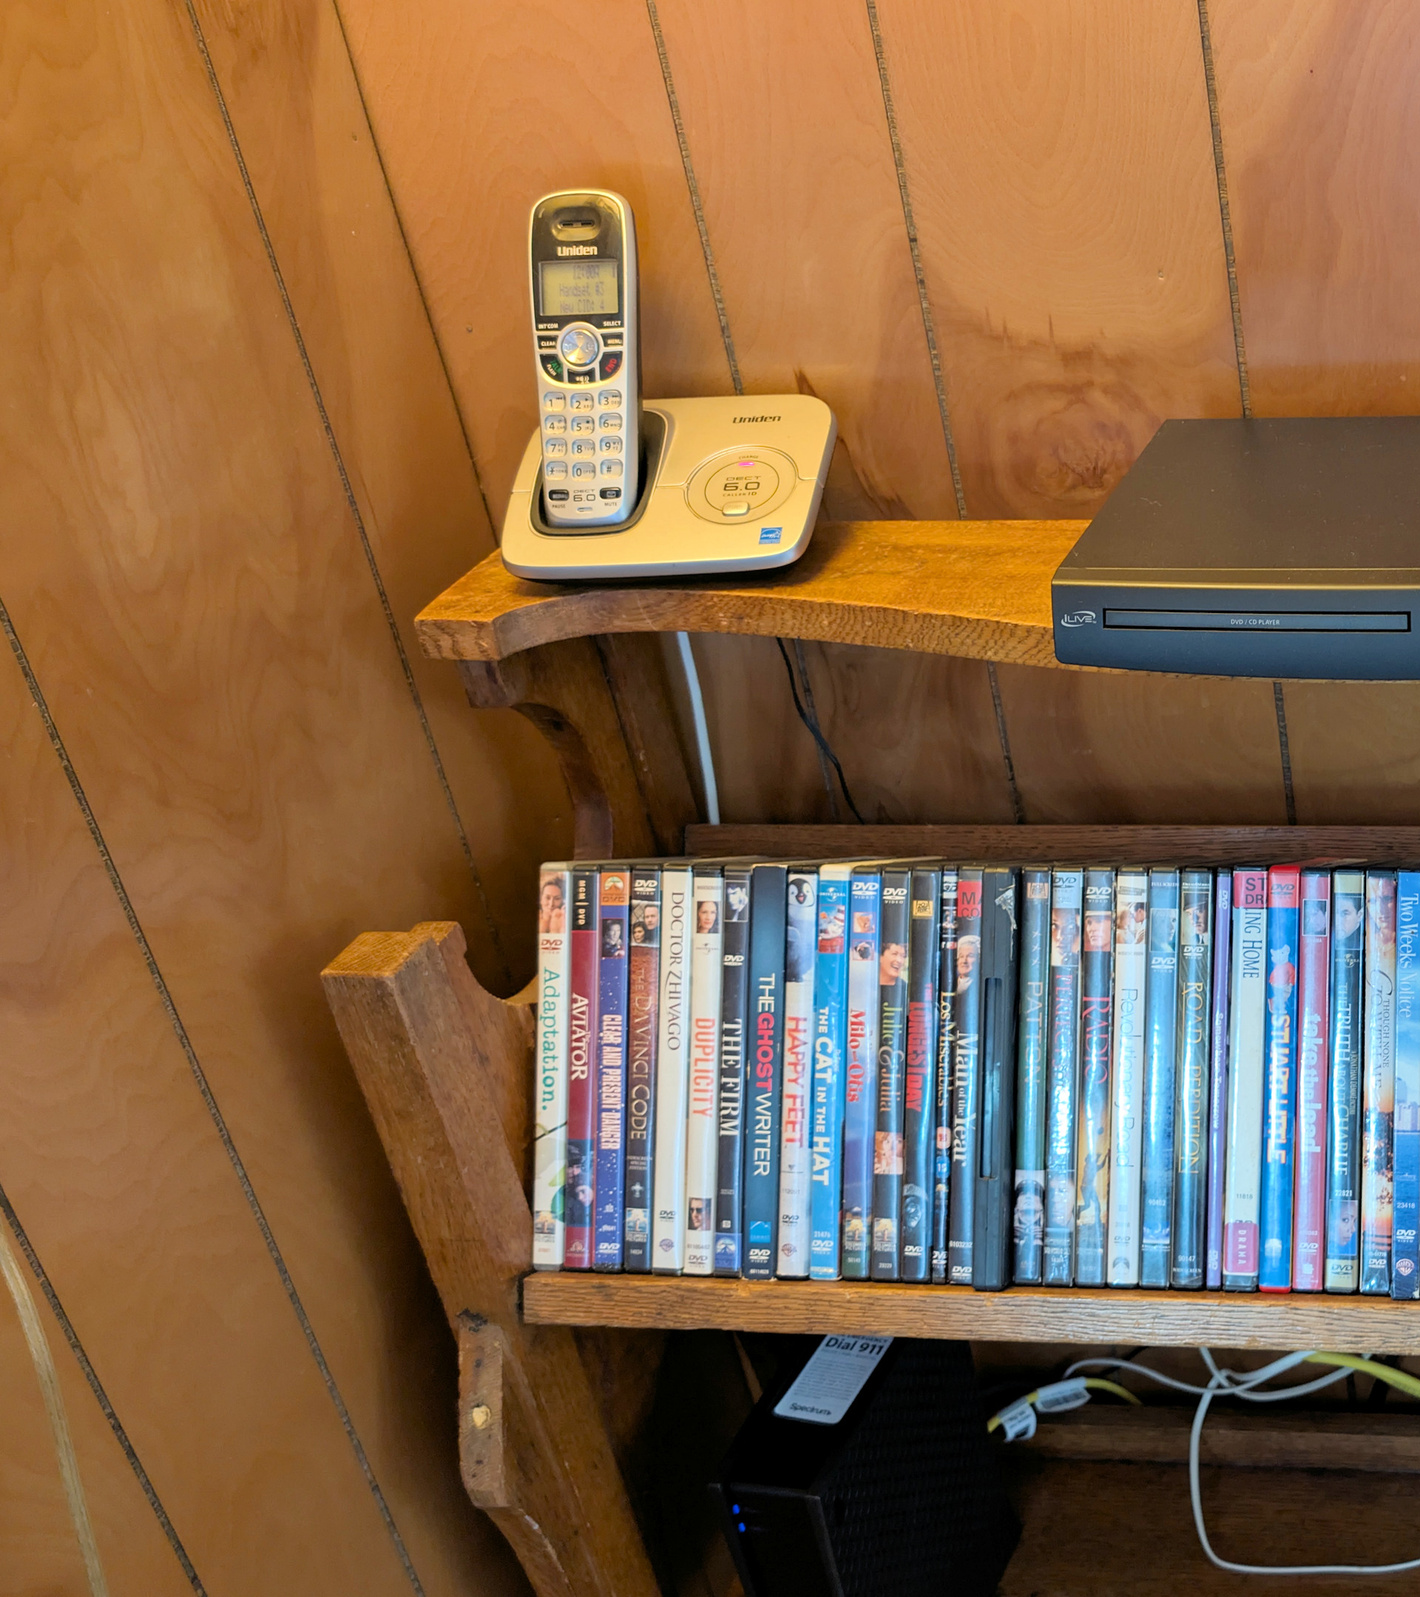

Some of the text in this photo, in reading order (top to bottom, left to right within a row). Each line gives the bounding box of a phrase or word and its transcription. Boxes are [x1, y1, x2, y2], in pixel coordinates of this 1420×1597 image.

[557, 245, 598, 256] Uniden
[605, 358, 617, 373] END
[549, 399, 553, 407] 1
[549, 422, 555, 430] 4
[576, 400, 581, 409] 2
[577, 423, 582, 431] 5
[603, 419, 609, 428] 6
[604, 396, 609, 405] 3
[732, 415, 781, 424] Uniden
[551, 444, 556, 452] 7
[576, 445, 583, 453] 8
[605, 442, 611, 450] 9
[573, 494, 595, 502] 6.0
[723, 481, 760, 491] 6.0
[578, 880, 586, 925] MGM DVD
[634, 879, 658, 887] DVD
[852, 882, 879, 890] DVD
[883, 888, 908, 896] DVD
[664, 892, 684, 1051] DOCTOR ZHIVAGO
[1242, 939, 1262, 978] HOME
[1399, 893, 1419, 1019] Two Weeks Notice
[541, 967, 560, 1111] Adaptation.
[571, 993, 589, 1080] AVIATOR
[1025, 981, 1043, 1083] PATTON
[1082, 996, 1110, 1084] RADIO
[1182, 981, 1203, 1044] ROAD
[631, 968, 650, 1140] THE VINCI CODE
[692, 1018, 715, 1118] DUPLICITY
[719, 1018, 742, 1137] THE FIRM
[753, 973, 775, 1176] THE GHOST WRITER
[786, 1016, 808, 1088] HAPPY
[847, 1009, 866, 1103] Milo Otis
[879, 1002, 904, 1112] Julie & Julia
[906, 1001, 931, 1112] LONGEST DAY
[1114, 988, 1141, 1168] Revolutionary Road
[1212, 1013, 1224, 1129] Somewhere Tomorrow
[1334, 982, 1351, 1176] THE TRUTH ABOUT CHARLIE
[1382, 1041, 1390, 1068] NONE
[601, 1014, 622, 1150] CLEAR AND PRESENT DANGER
[812, 1006, 832, 1186] THE CAT IN THE HAT
[953, 1030, 978, 1167] Man of the Year
[1267, 1014, 1290, 1164] STUART LITTLE
[1302, 1013, 1323, 1153] take the lead
[784, 1093, 805, 1148] FEET
[1238, 1230, 1246, 1264] DRAMA
[825, 1337, 855, 1351] Dial
[858, 1342, 884, 1356] 911
[789, 1402, 830, 1416] Spectrum
